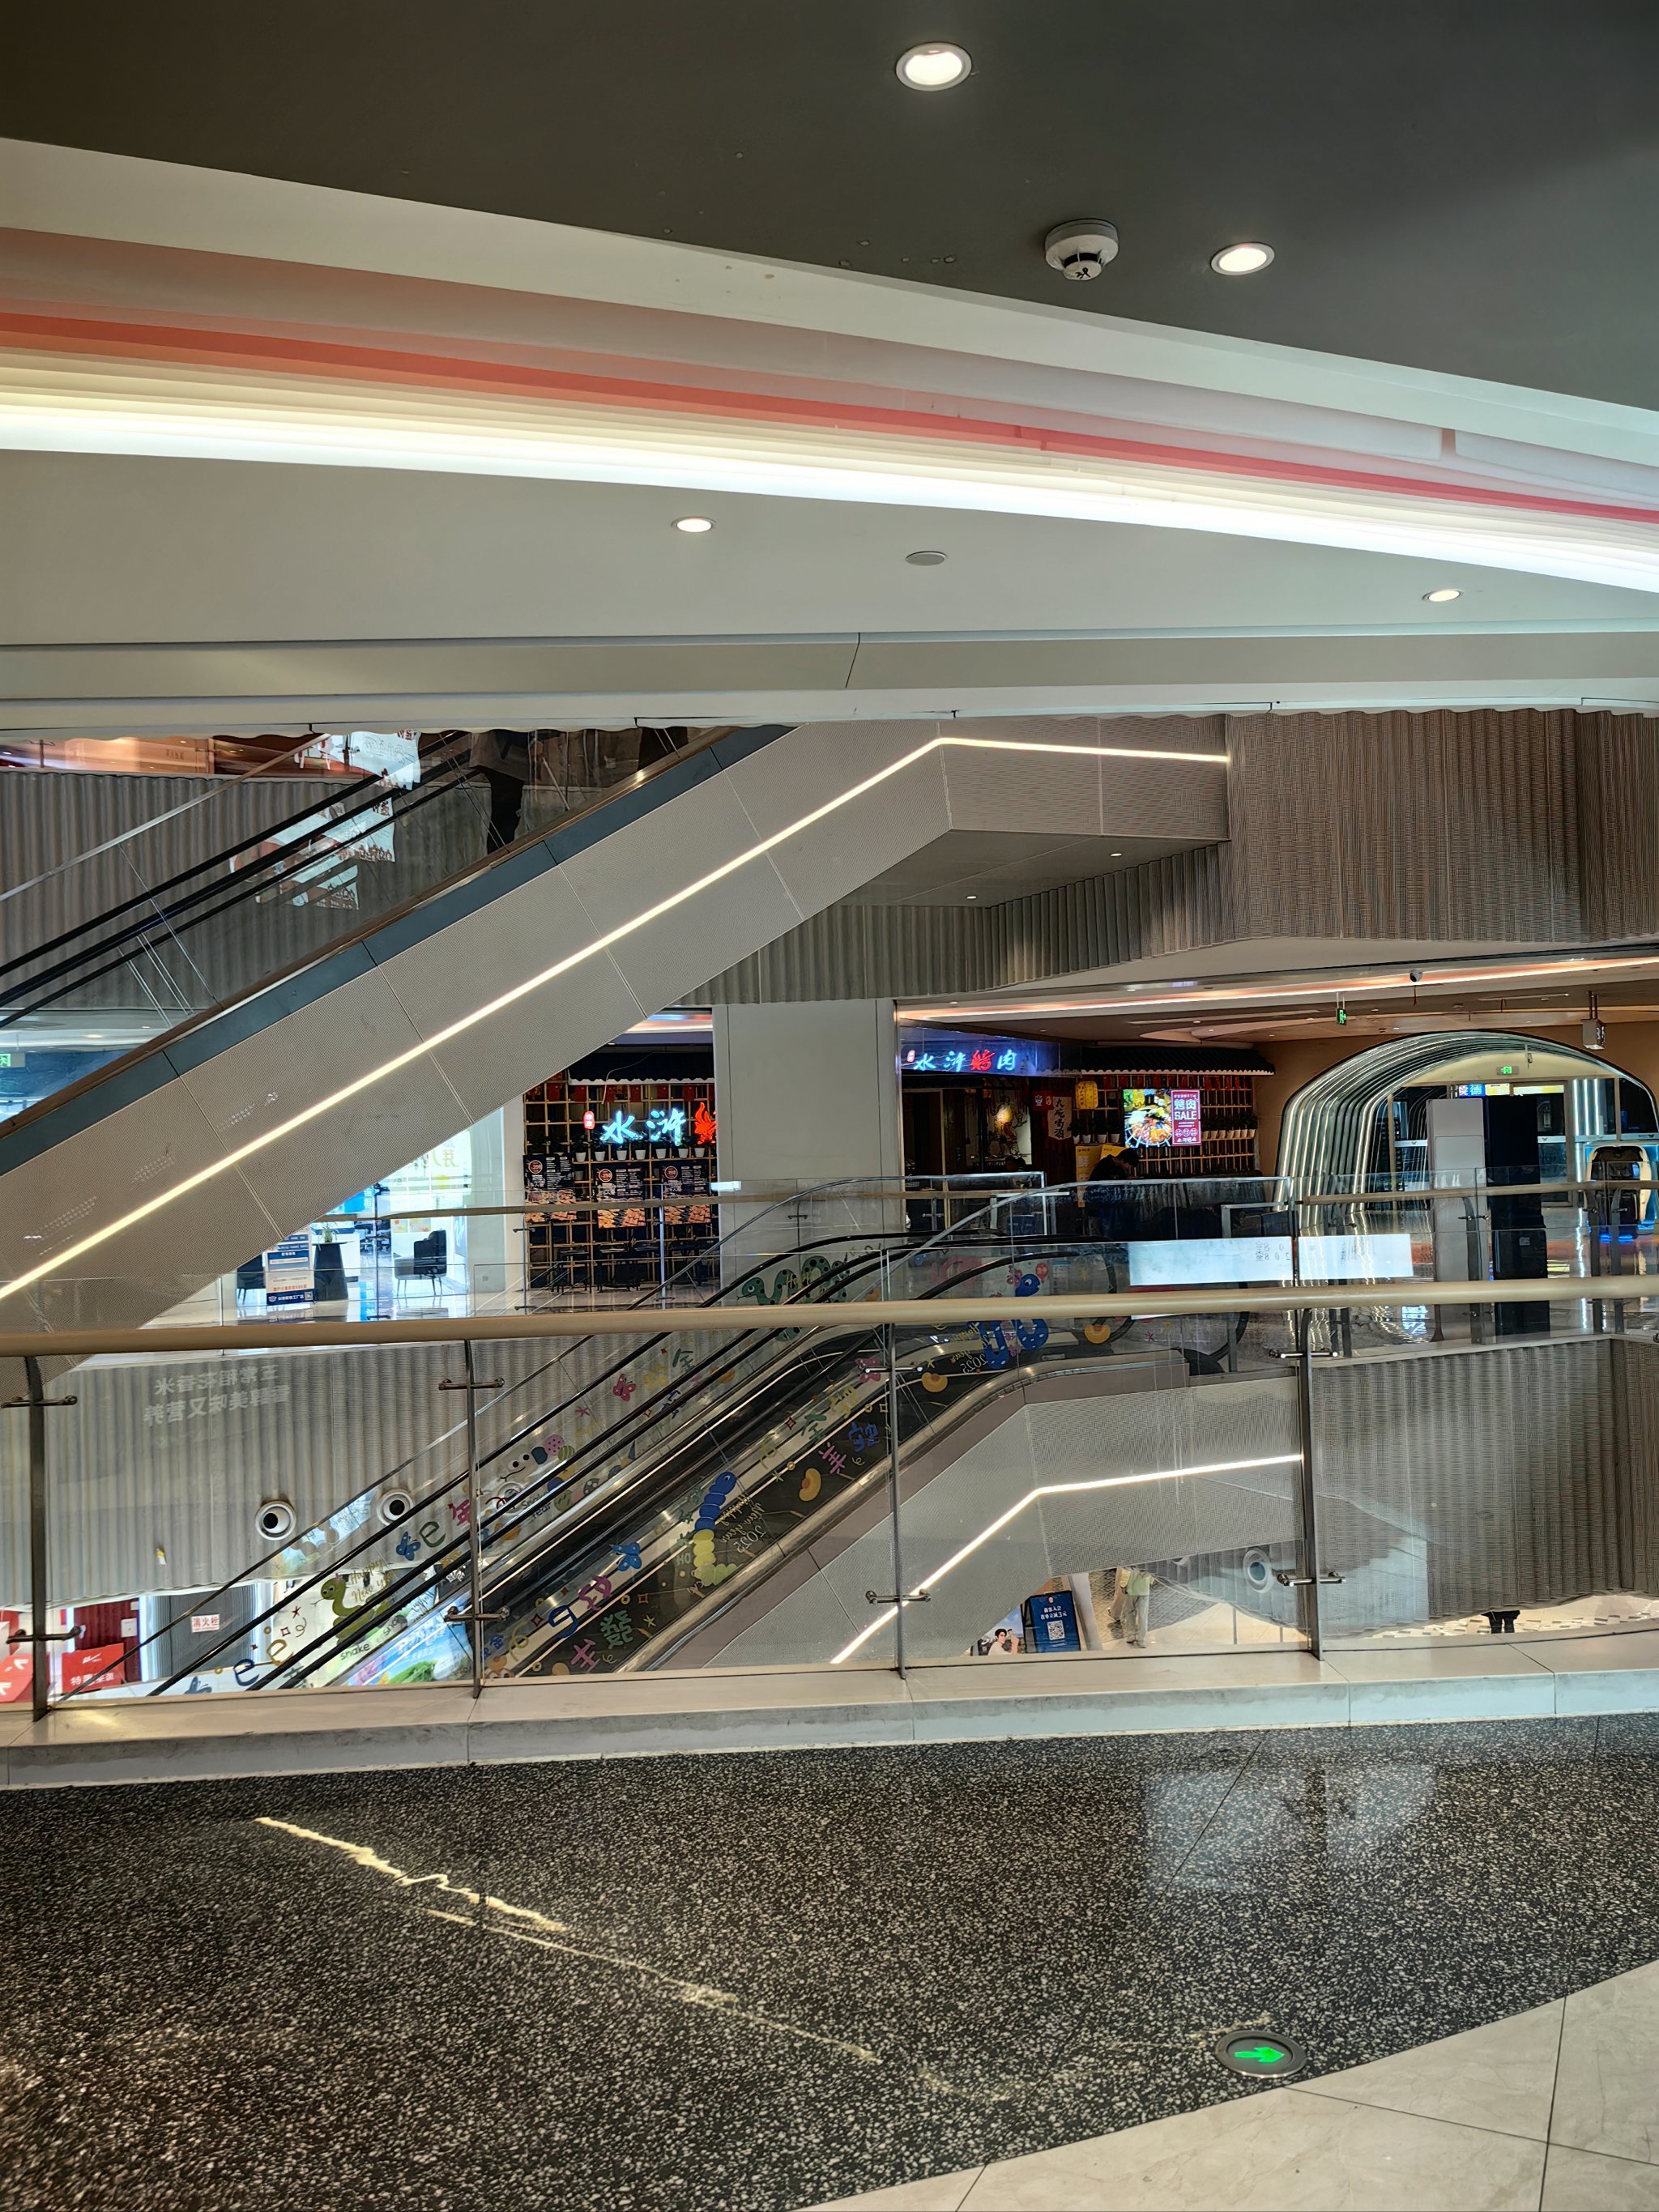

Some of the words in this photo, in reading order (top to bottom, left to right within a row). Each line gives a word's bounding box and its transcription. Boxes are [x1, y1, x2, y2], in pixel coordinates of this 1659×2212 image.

[913, 1049, 1017, 1072] 水浒烤肉
[1175, 1110, 1197, 1120] SALE
[339, 1643, 371, 1660] snake
